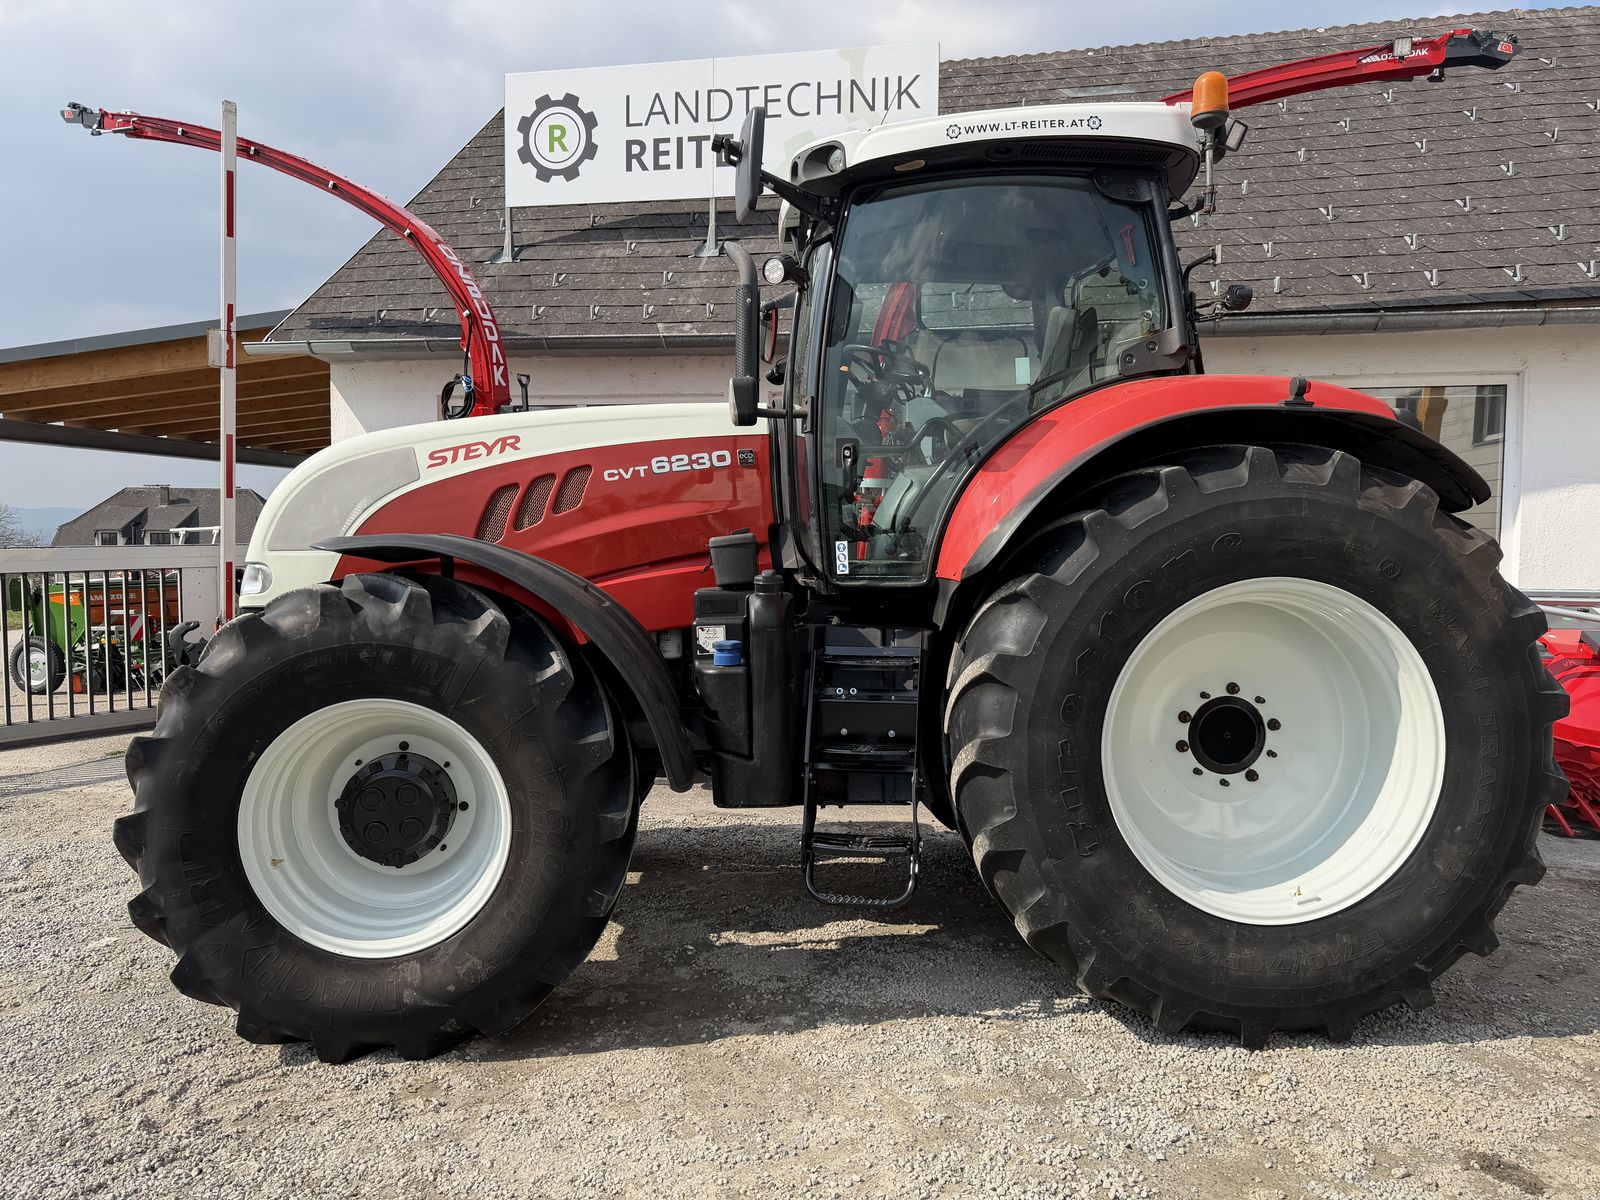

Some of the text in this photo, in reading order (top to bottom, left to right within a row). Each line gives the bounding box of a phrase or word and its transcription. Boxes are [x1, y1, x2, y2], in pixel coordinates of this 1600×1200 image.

[625, 74, 921, 128] LANDTECHNIK
[548, 124, 569, 153] R
[964, 119, 1085, 135] WWW.LT-REITER.AT
[426, 434, 521, 468] STEYR
[603, 450, 732, 482] CVT 6230
[90, 592, 137, 601] AMZOE
